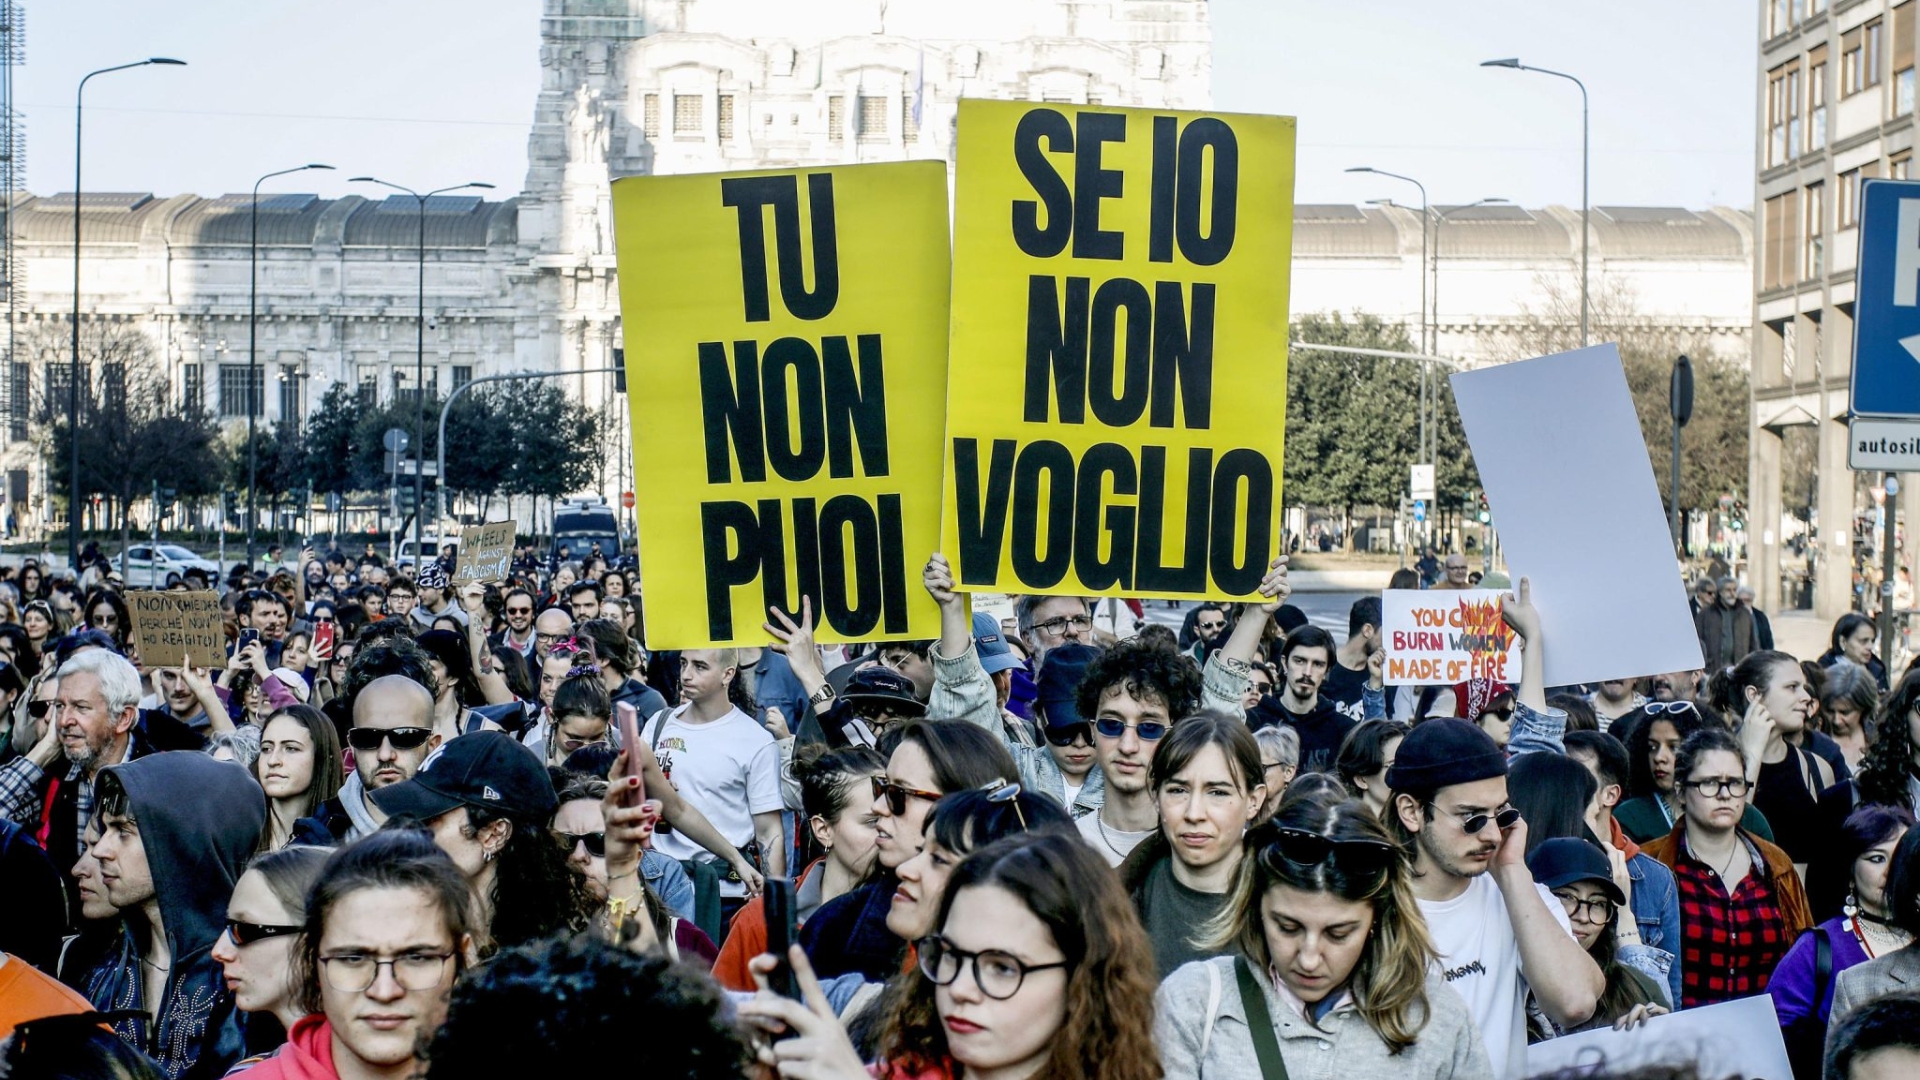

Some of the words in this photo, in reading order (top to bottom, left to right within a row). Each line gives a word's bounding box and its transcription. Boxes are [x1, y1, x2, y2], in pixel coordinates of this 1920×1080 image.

[1012, 109, 1126, 260] SE
[1149, 116, 1239, 267] IO
[721, 172, 839, 323] TU
[1024, 274, 1216, 430] NON
[698, 334, 890, 485] NON
[953, 438, 1273, 597] VOGLIO
[467, 529, 507, 548] WHEELS
[479, 547, 505, 560] AGAINST
[701, 494, 909, 643] PUOI
[137, 597, 172, 611] NON
[189, 617, 210, 630] NON
[1411, 608, 1446, 627] YOU
[142, 634, 157, 644] HO
[1393, 630, 1444, 651] BURN
[1449, 633, 1507, 652] WOMEN
[1389, 658, 1442, 680] MADE
[1446, 660, 1467, 681] OF
[1470, 653, 1508, 681] FIRE
